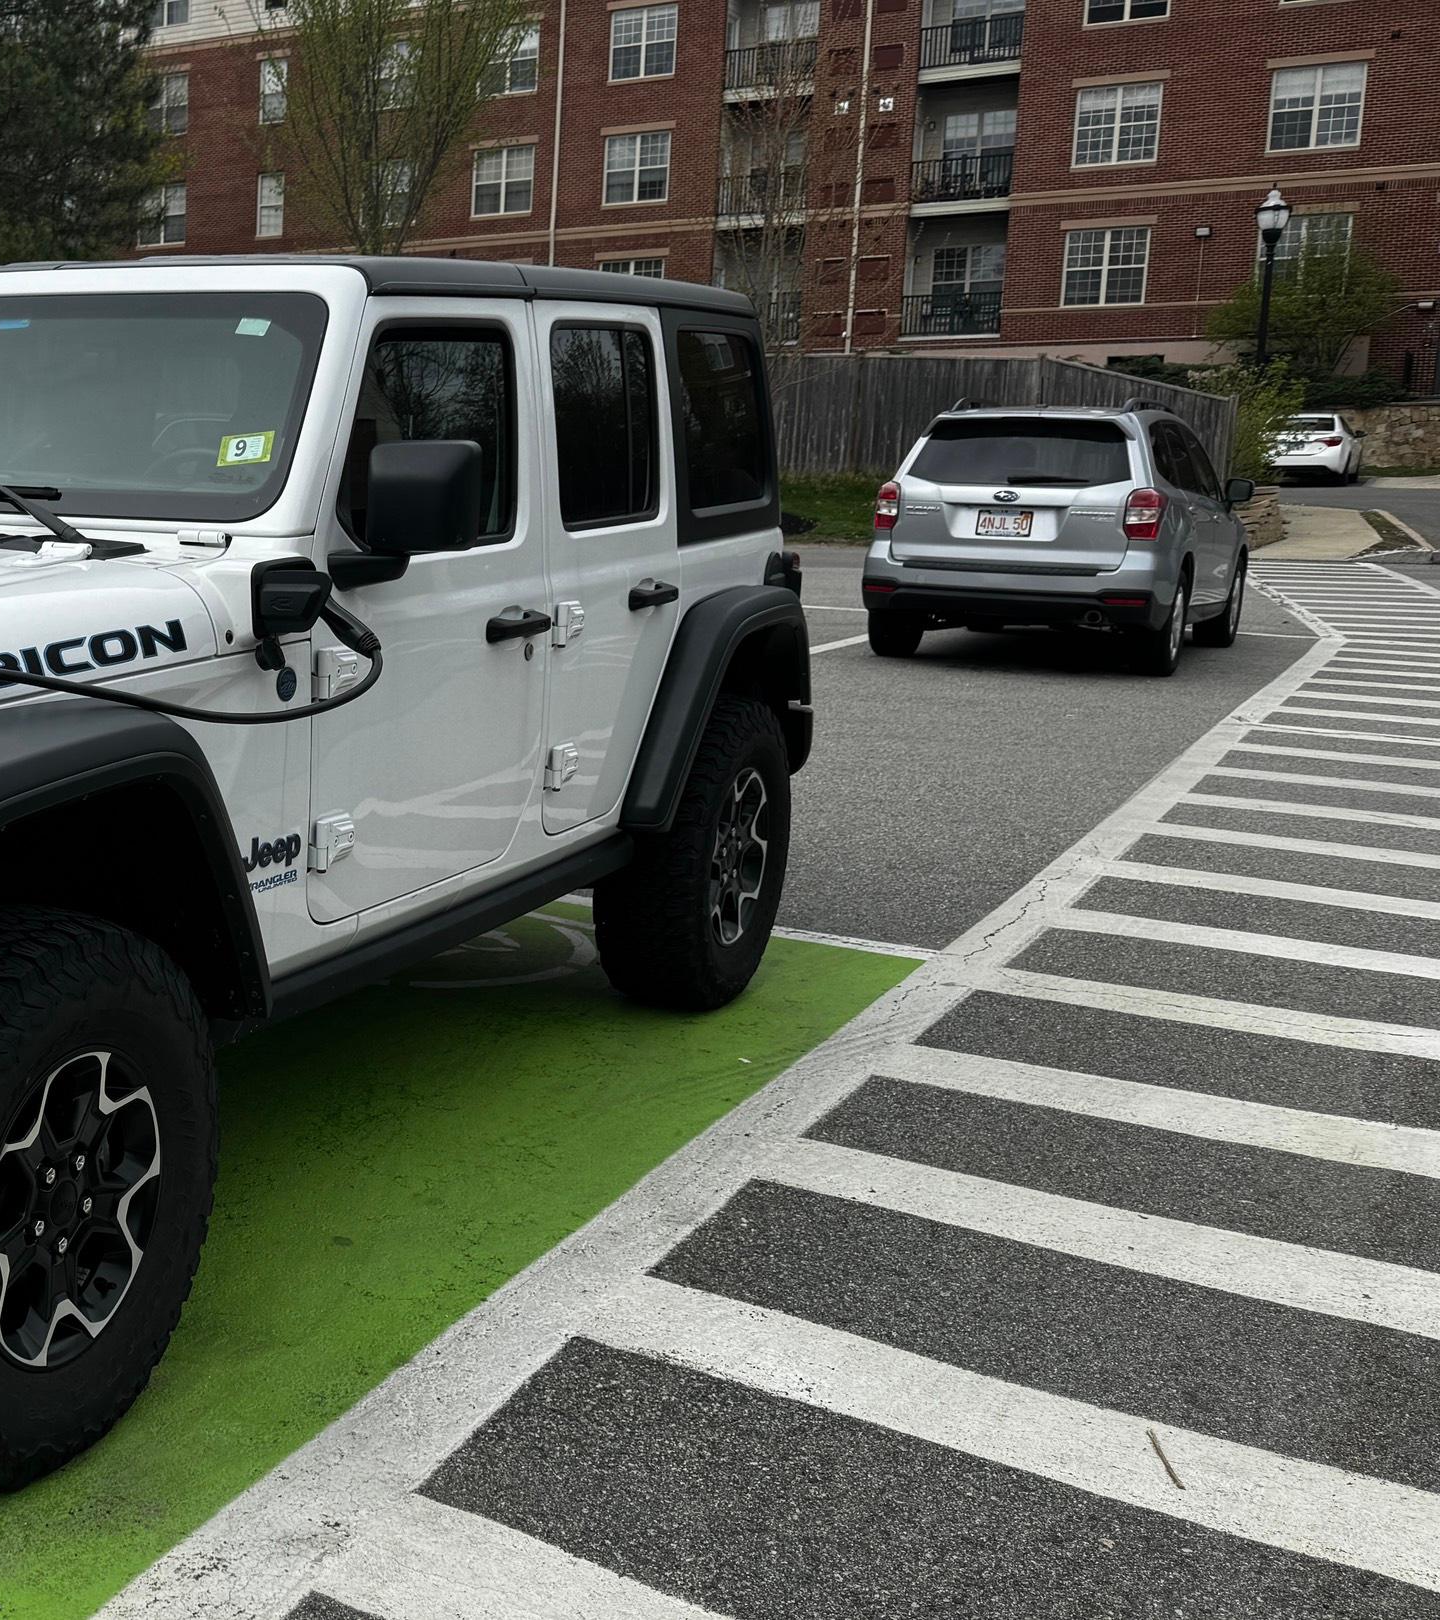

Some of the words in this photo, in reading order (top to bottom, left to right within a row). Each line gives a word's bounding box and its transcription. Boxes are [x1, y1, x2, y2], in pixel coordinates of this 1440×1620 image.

[234, 439, 247, 457] 9
[980, 516, 1009, 530] 4NJL
[1013, 517, 1029, 531] 50
[241, 833, 301, 873] Jeep
[249, 869, 298, 891] RANGLER
